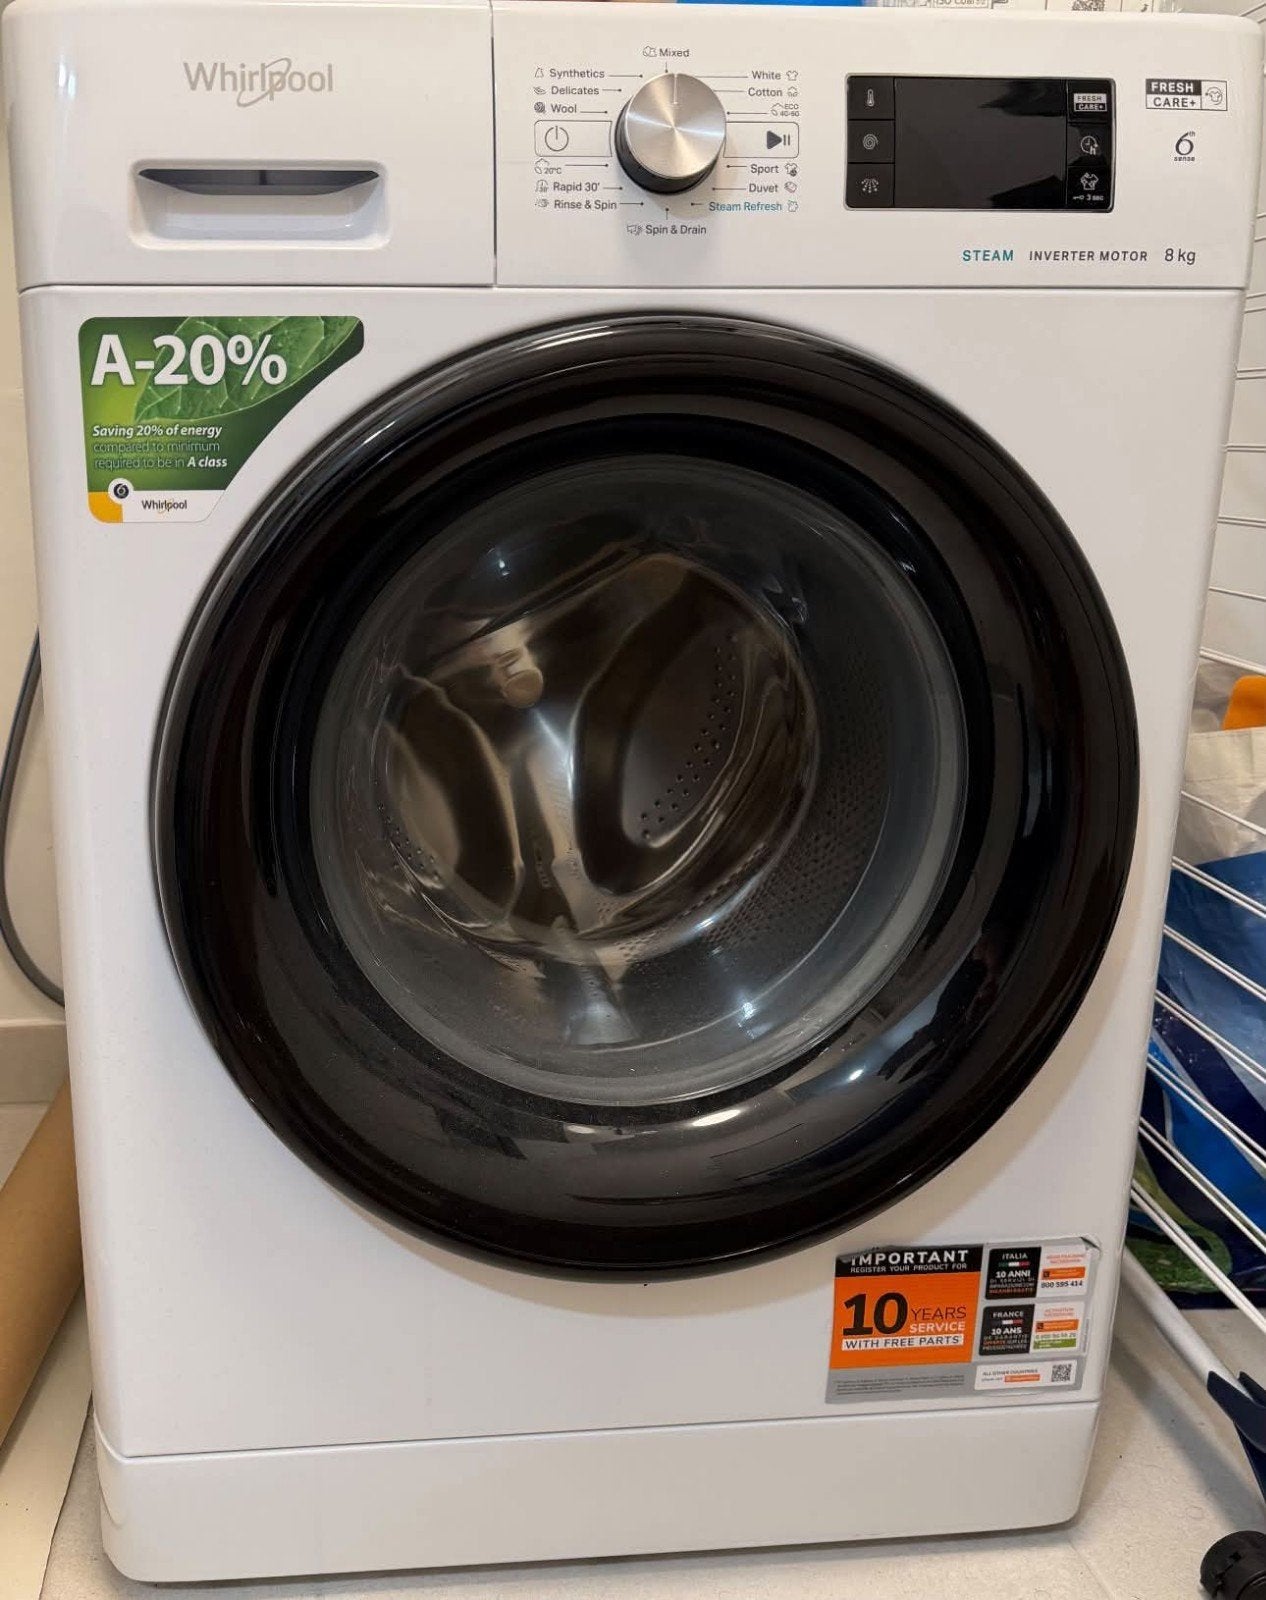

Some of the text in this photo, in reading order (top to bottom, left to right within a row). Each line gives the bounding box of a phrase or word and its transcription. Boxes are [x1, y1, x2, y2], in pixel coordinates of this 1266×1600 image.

[660, 48, 690, 57] Mixed
[549, 68, 605, 80] Synthetics
[752, 70, 781, 80] White
[183, 60, 334, 104] Whirlpool
[1151, 81, 1194, 93] FRESH
[551, 85, 600, 95] Delicates
[748, 87, 783, 97] Cotton
[550, 103, 577, 113] Wool
[1153, 97, 1196, 107] CARE+
[750, 163, 779, 176] Sport
[553, 181, 600, 193] Rapid 30'
[748, 183, 779, 193] Duvet
[554, 199, 617, 211] Rinse & Spin
[709, 201, 782, 211] Steam Refresh
[645, 224, 707, 236] Spin & Drain
[962, 249, 1014, 262] STEAM
[1029, 250, 1148, 262] INVERTER MOTOR
[1164, 248, 1196, 266] 8 kg
[90, 334, 288, 386] A-20%
[92, 423, 222, 440] Saving 20% of energy
[93, 441, 220, 456] compared to minimum
[95, 456, 228, 471] required to be in A class
[141, 499, 187, 512] Whirlpool
[851, 1250, 969, 1266] IMPORTANT
[1001, 1252, 1028, 1260] ITALIA
[850, 1262, 967, 1273] REGISTER YOUR PRODUCT FOR
[995, 1269, 1031, 1279] 10 ANNI
[843, 1292, 908, 1336] 10
[911, 1306, 967, 1321] YEARS
[992, 1310, 1024, 1318] FRANCE
[909, 1321, 966, 1334] SERVICE
[991, 1327, 1022, 1336] 10 ANS
[845, 1335, 960, 1350] WITH FREE PARTS
